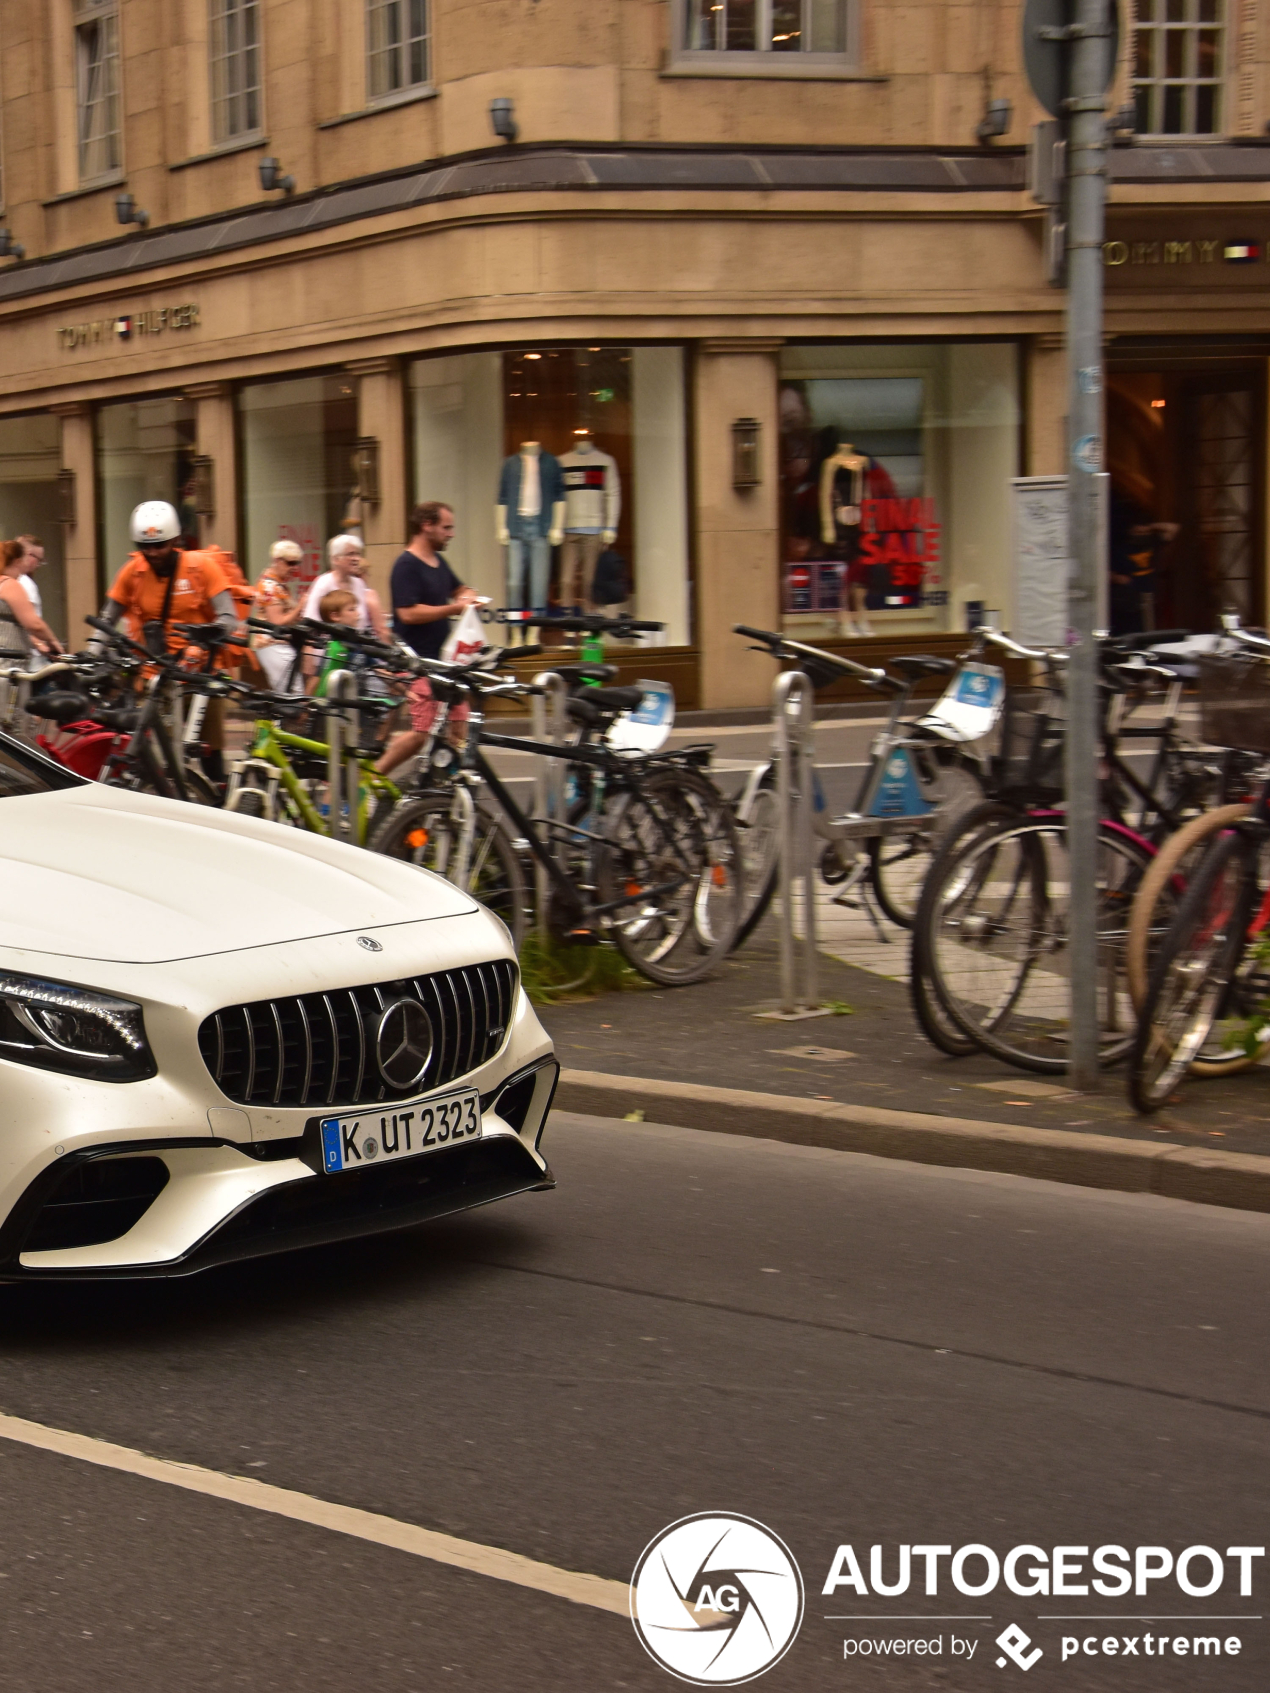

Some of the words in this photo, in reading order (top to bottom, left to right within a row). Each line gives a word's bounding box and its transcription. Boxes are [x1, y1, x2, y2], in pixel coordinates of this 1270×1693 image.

[1101, 240, 1219, 265] OMMY
[55, 317, 117, 348] TOMMY
[134, 303, 202, 335] HILFIGER
[861, 498, 942, 532] FINAL
[859, 532, 941, 565] SALE
[342, 1121, 362, 1162] K
[380, 1112, 415, 1153] UT
[421, 1097, 478, 1147] 2323
[329, 1151, 337, 1162] D
